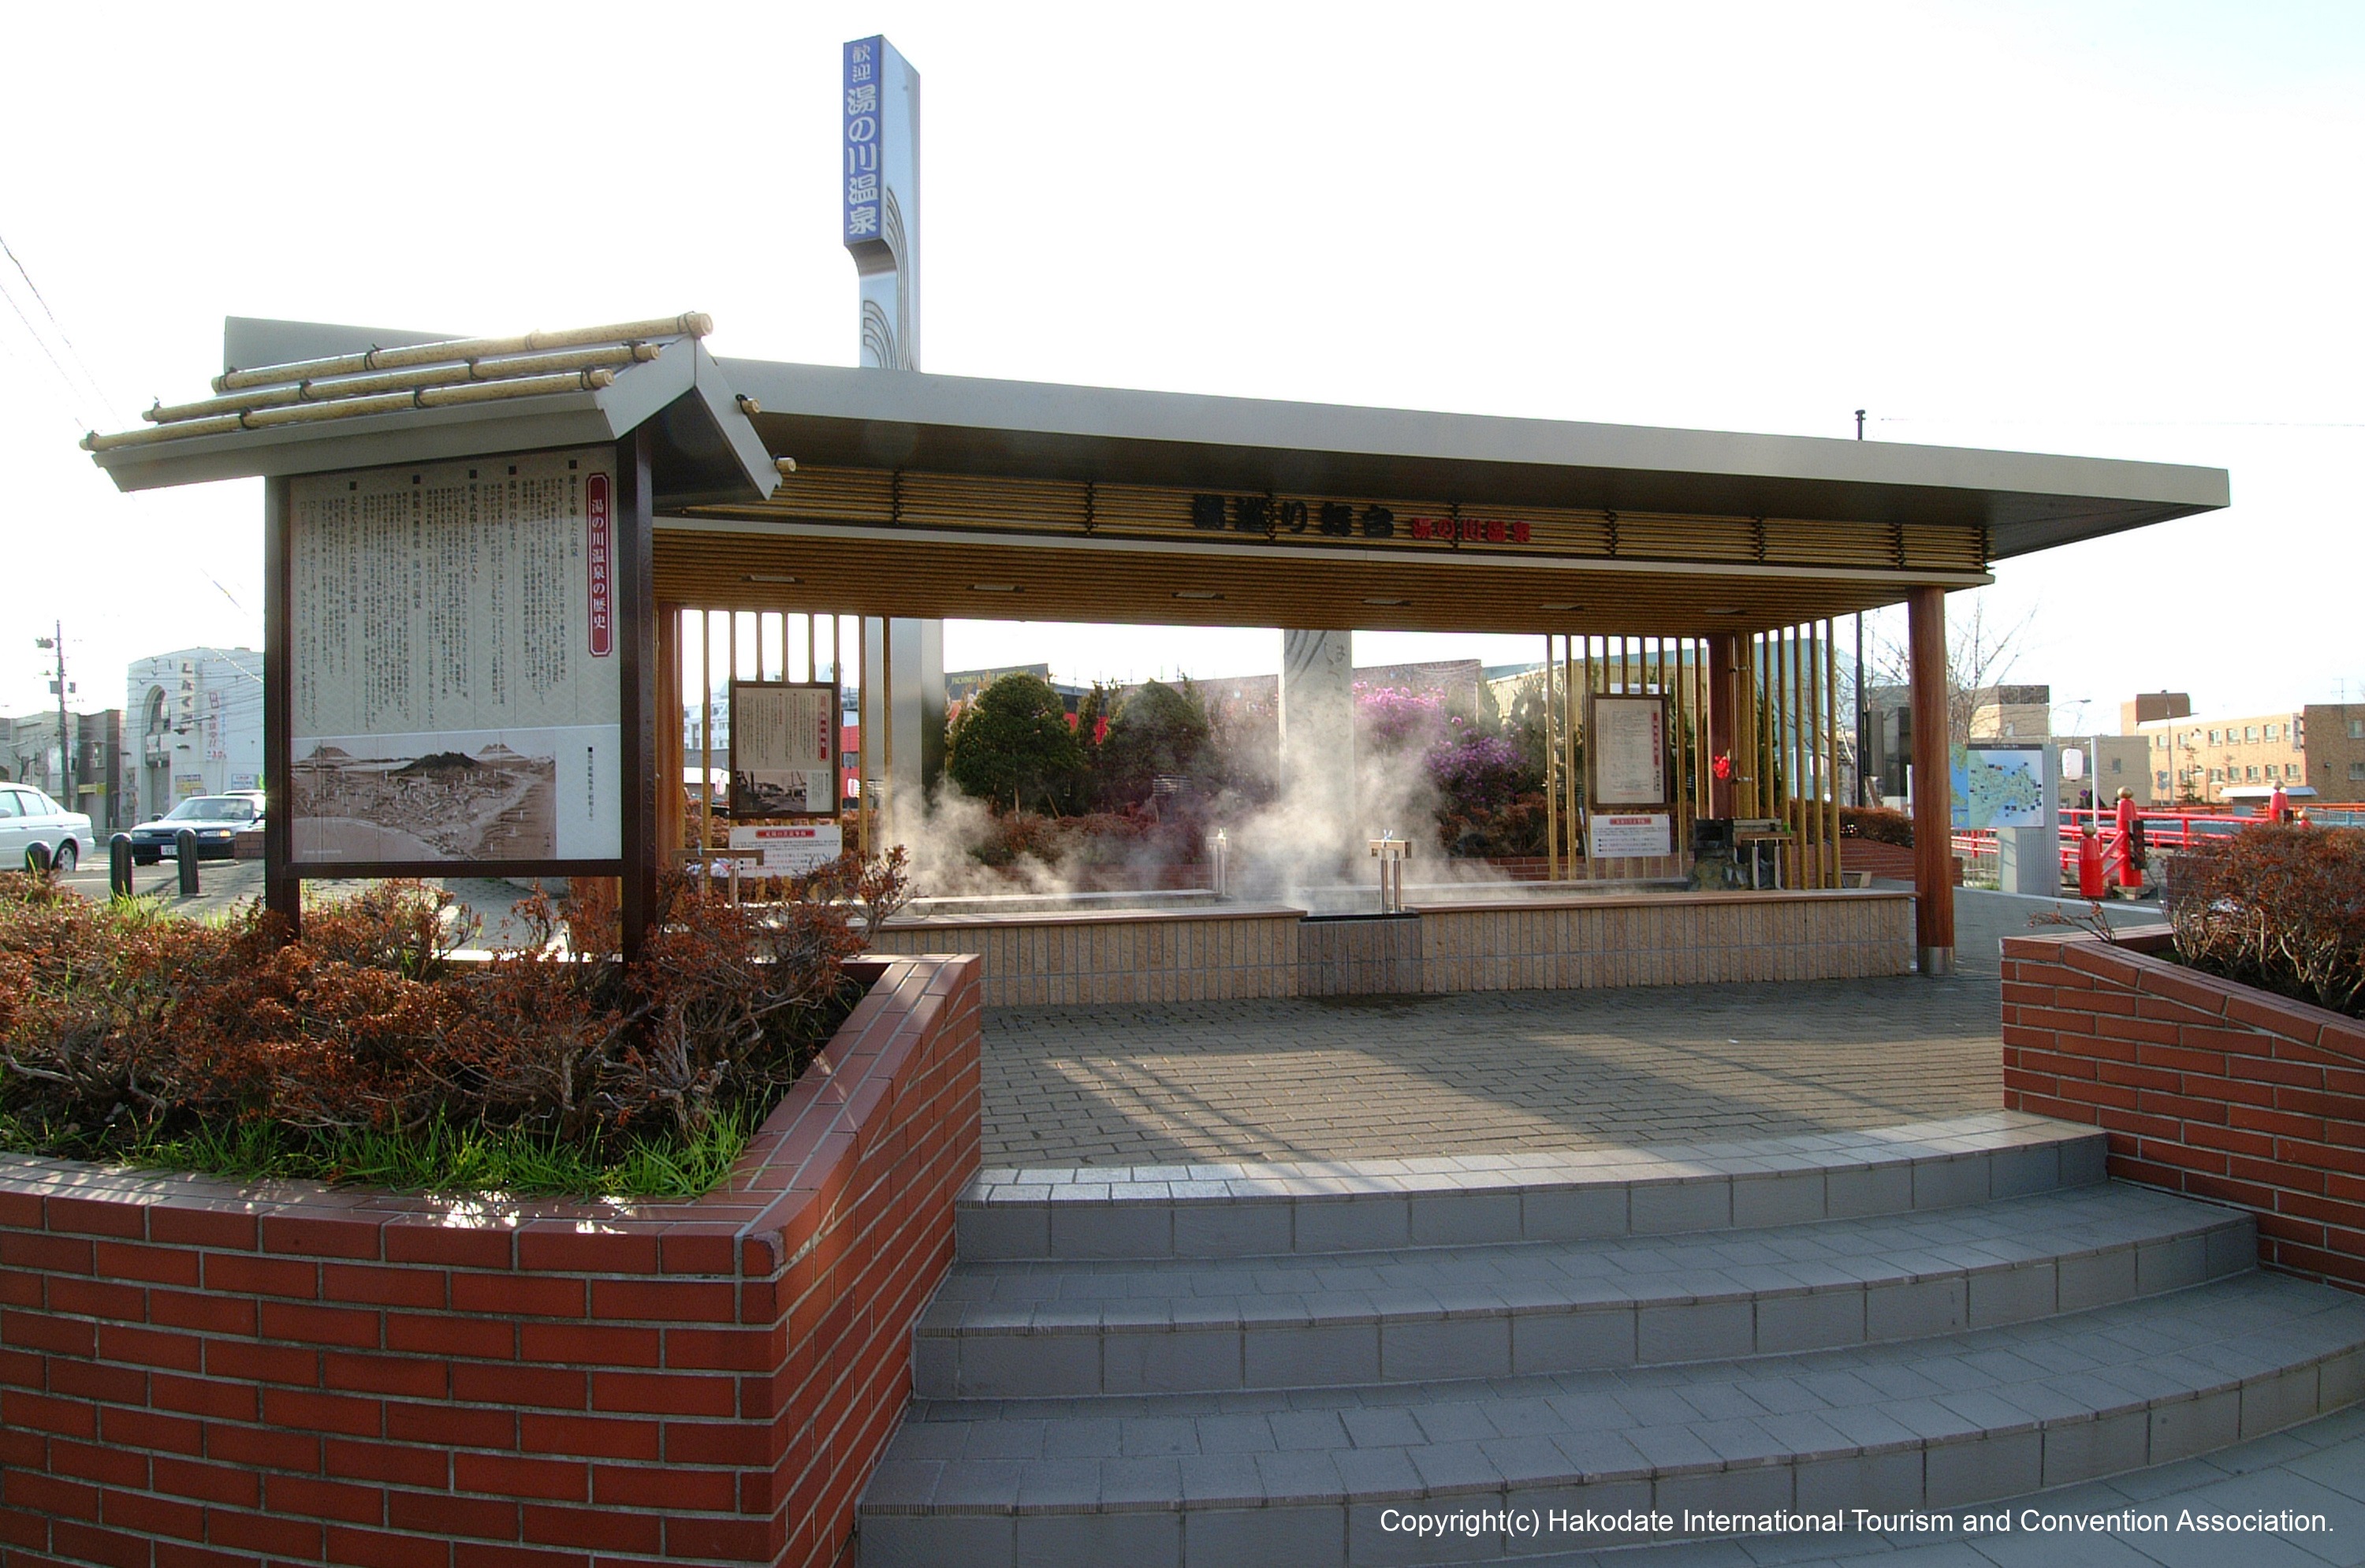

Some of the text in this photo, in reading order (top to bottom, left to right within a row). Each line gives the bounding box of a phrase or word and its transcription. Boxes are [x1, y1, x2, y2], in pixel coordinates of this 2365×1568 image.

[847, 44, 878, 235] 歓迎 湯の川温泉
[591, 498, 606, 629] 湯の川温泉の歴史
[1412, 517, 1531, 542] 湯の川温泉
